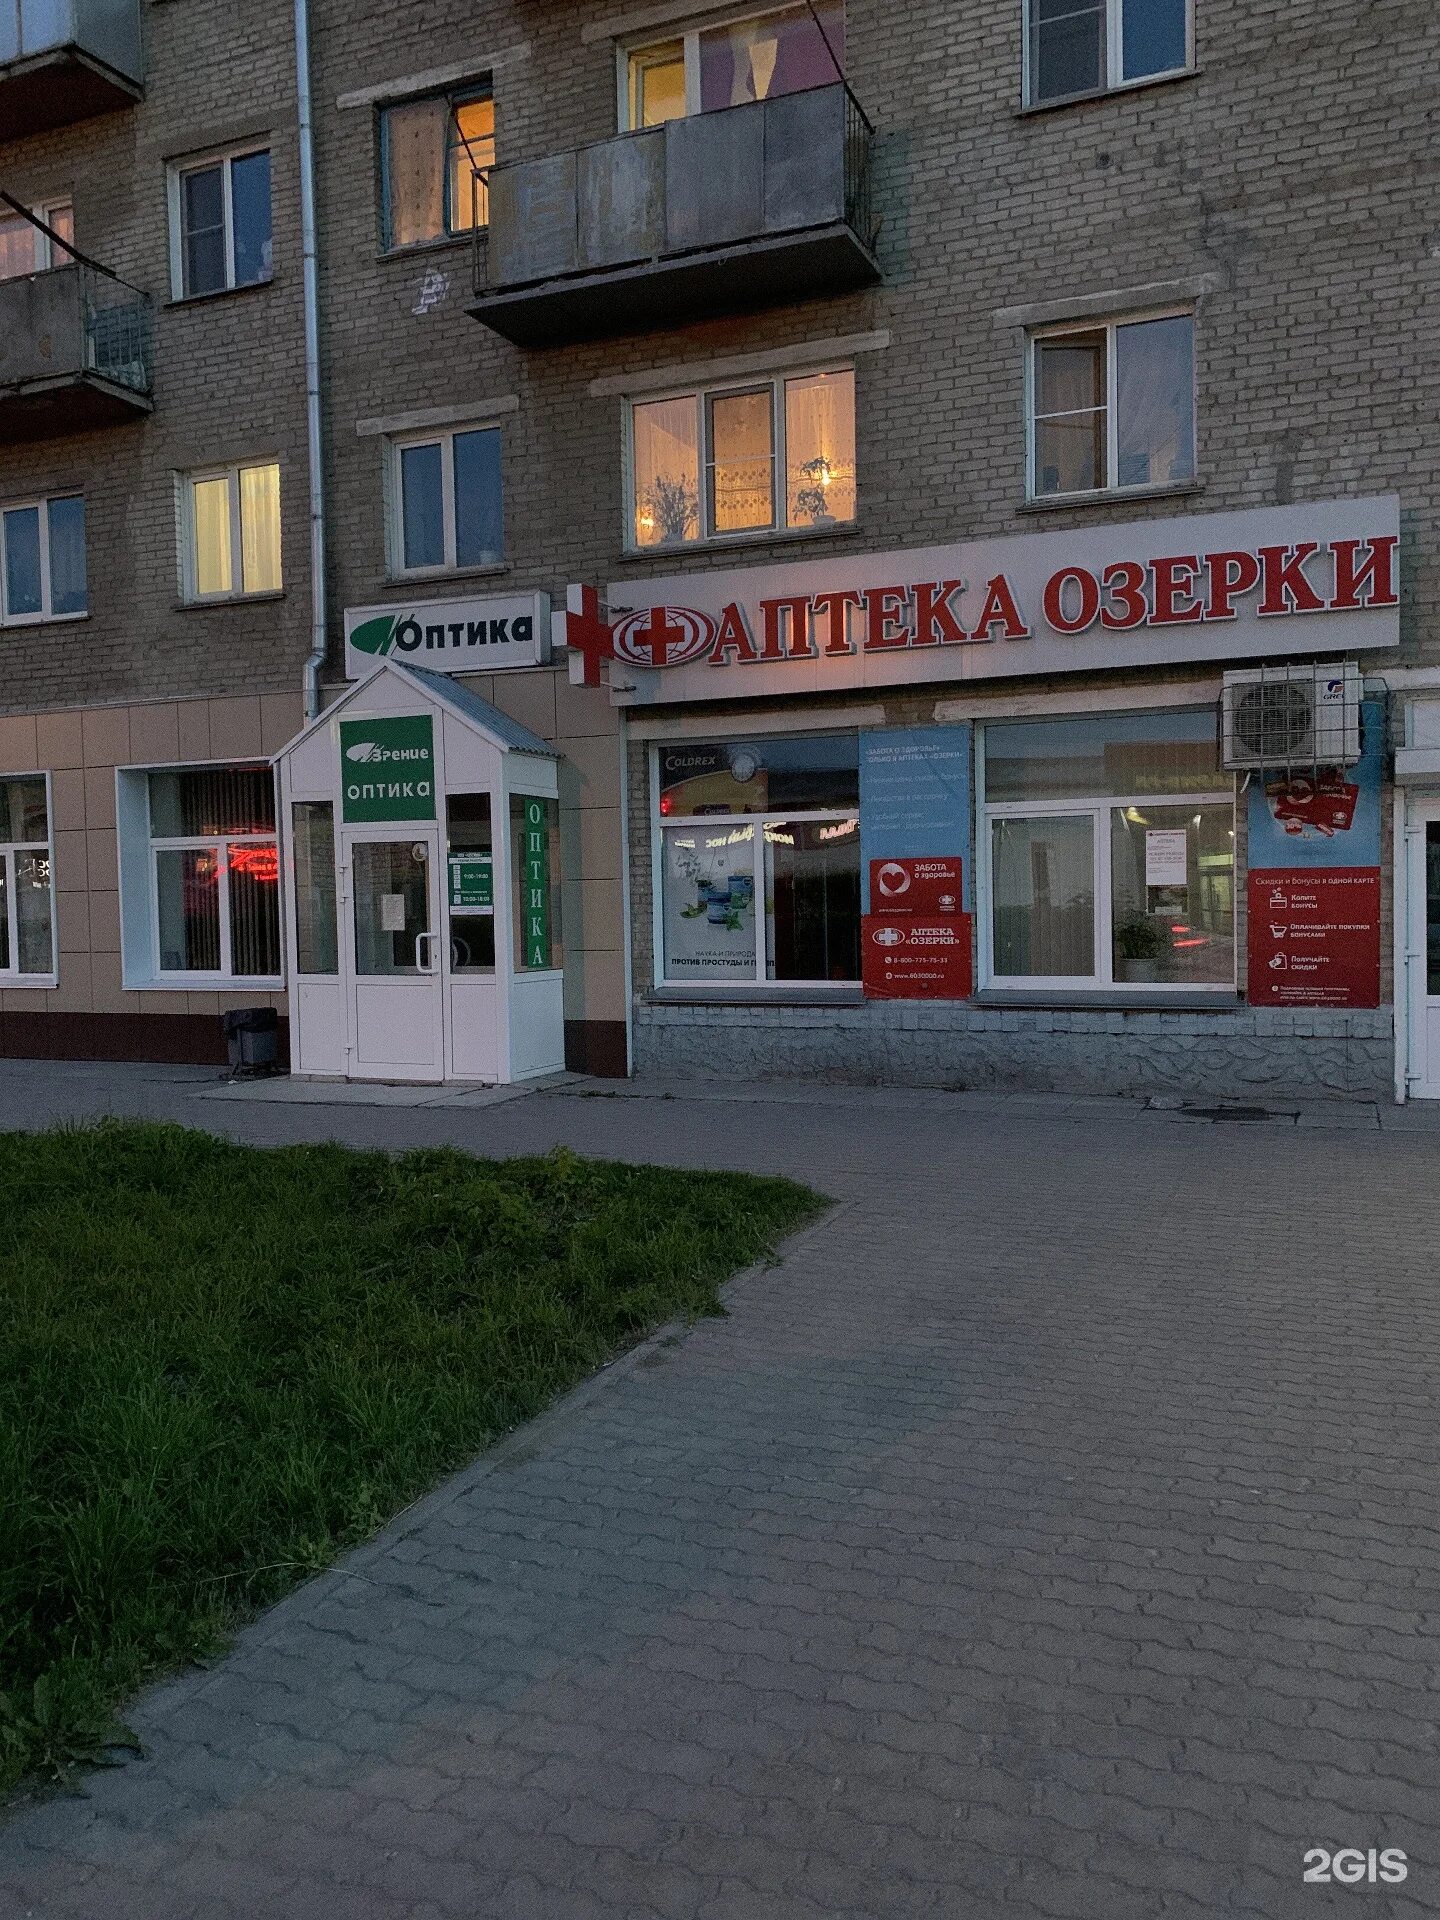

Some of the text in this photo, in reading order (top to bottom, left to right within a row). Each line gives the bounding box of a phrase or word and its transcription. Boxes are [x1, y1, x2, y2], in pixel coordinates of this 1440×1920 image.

[706, 535, 1399, 665] АПТЕКА ОЗЕРКИ
[395, 615, 533, 652] Оптика
[914, 863, 947, 872] ЗАБОТА
[920, 871, 956, 880] здоровье
[529, 803, 544, 965] ОПТИКА
[1255, 877, 1284, 886] Скидки
[1292, 877, 1321, 886] бонусы
[910, 928, 954, 936] АПТЕКА
